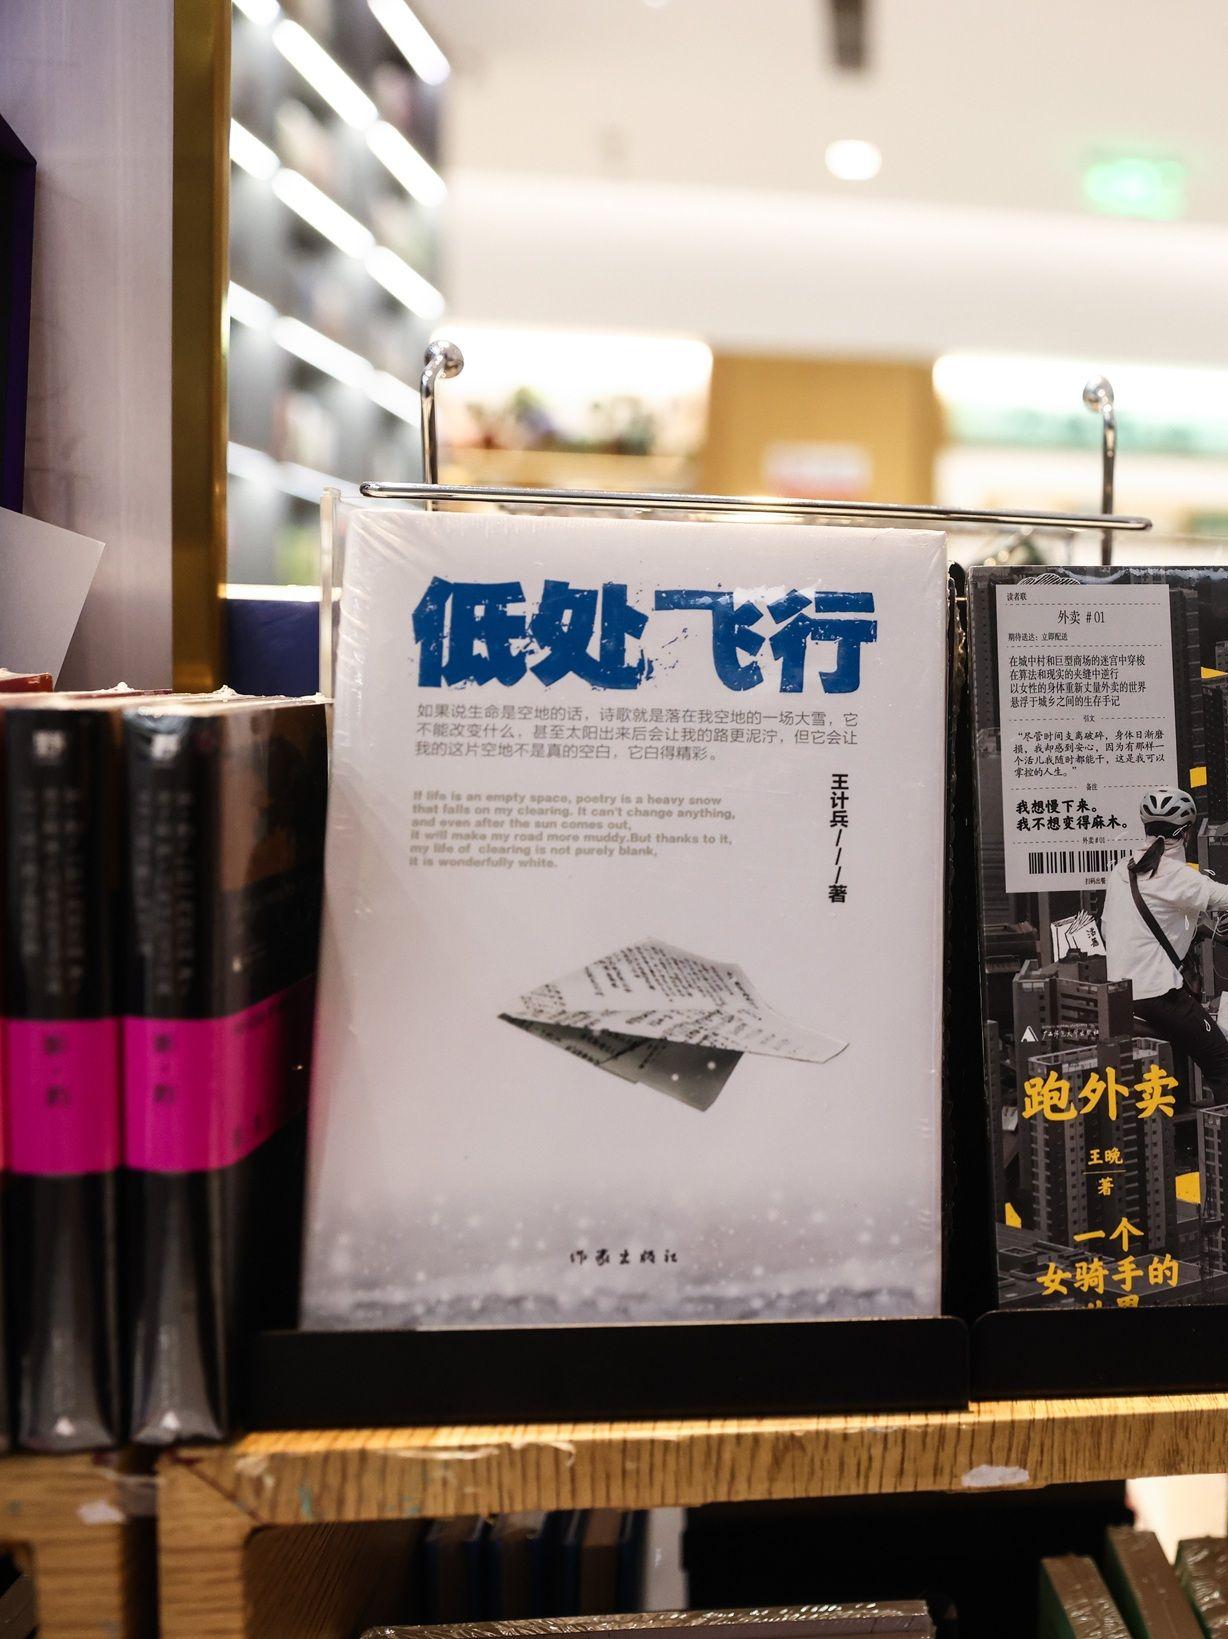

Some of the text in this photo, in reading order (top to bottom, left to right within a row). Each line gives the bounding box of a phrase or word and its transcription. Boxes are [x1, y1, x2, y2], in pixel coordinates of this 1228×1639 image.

[1058, 610, 1080, 624] 外卖
[411, 576, 878, 693] 低处飞行
[1009, 654, 1146, 667] 在城中村和巨型商场的迷宫中穿梭
[1009, 668, 1119, 681] 在算法和现实的夹缝中逆行
[1010, 681, 1147, 694] 以女性的身体重新丈量外卖的世界
[1010, 695, 1121, 708] 悬浮于城乡之间的生存手记
[426, 791, 447, 801] life
[451, 792, 462, 802] is
[466, 793, 482, 802] an
[485, 793, 526, 804] empty
[576, 794, 617, 805] poetry
[620, 794, 632, 804] is
[635, 796, 643, 804] a
[647, 794, 685, 806] heavy
[689, 796, 722, 805] snow
[1016, 798, 1097, 814] 我想慢下来。
[412, 804, 439, 814] that
[443, 804, 470, 814] falls
[474, 806, 490, 815] on
[494, 806, 513, 817] my
[626, 807, 674, 819] change
[411, 817, 436, 828] and
[439, 820, 470, 828] even
[474, 818, 505, 828] after
[509, 818, 530, 828] the
[534, 820, 557, 829] sun
[561, 820, 603, 830] comes
[1016, 814, 1128, 831] 我不想变得麻木。
[424, 831, 448, 840] will
[451, 830, 487, 841] make
[491, 832, 510, 843] my
[514, 831, 544, 842] road
[547, 834, 580, 843] more
[656, 832, 699, 844] thanks
[703, 833, 716, 844] to
[410, 845, 429, 855] my
[433, 843, 454, 854] life
[457, 844, 471, 854] of
[478, 844, 531, 857] clearing
[535, 845, 546, 855] is
[550, 846, 571, 855] not
[575, 846, 615, 858] purely
[422, 857, 434, 867] is
[438, 857, 514, 869] wonderfully
[1022, 1064, 1179, 1122] 跑外卖
[1088, 1147, 1124, 1165] 王晚
[1098, 1176, 1114, 1196] 著
[1073, 1217, 1144, 1252] 一个
[1036, 1253, 1179, 1295] 女骑手的
